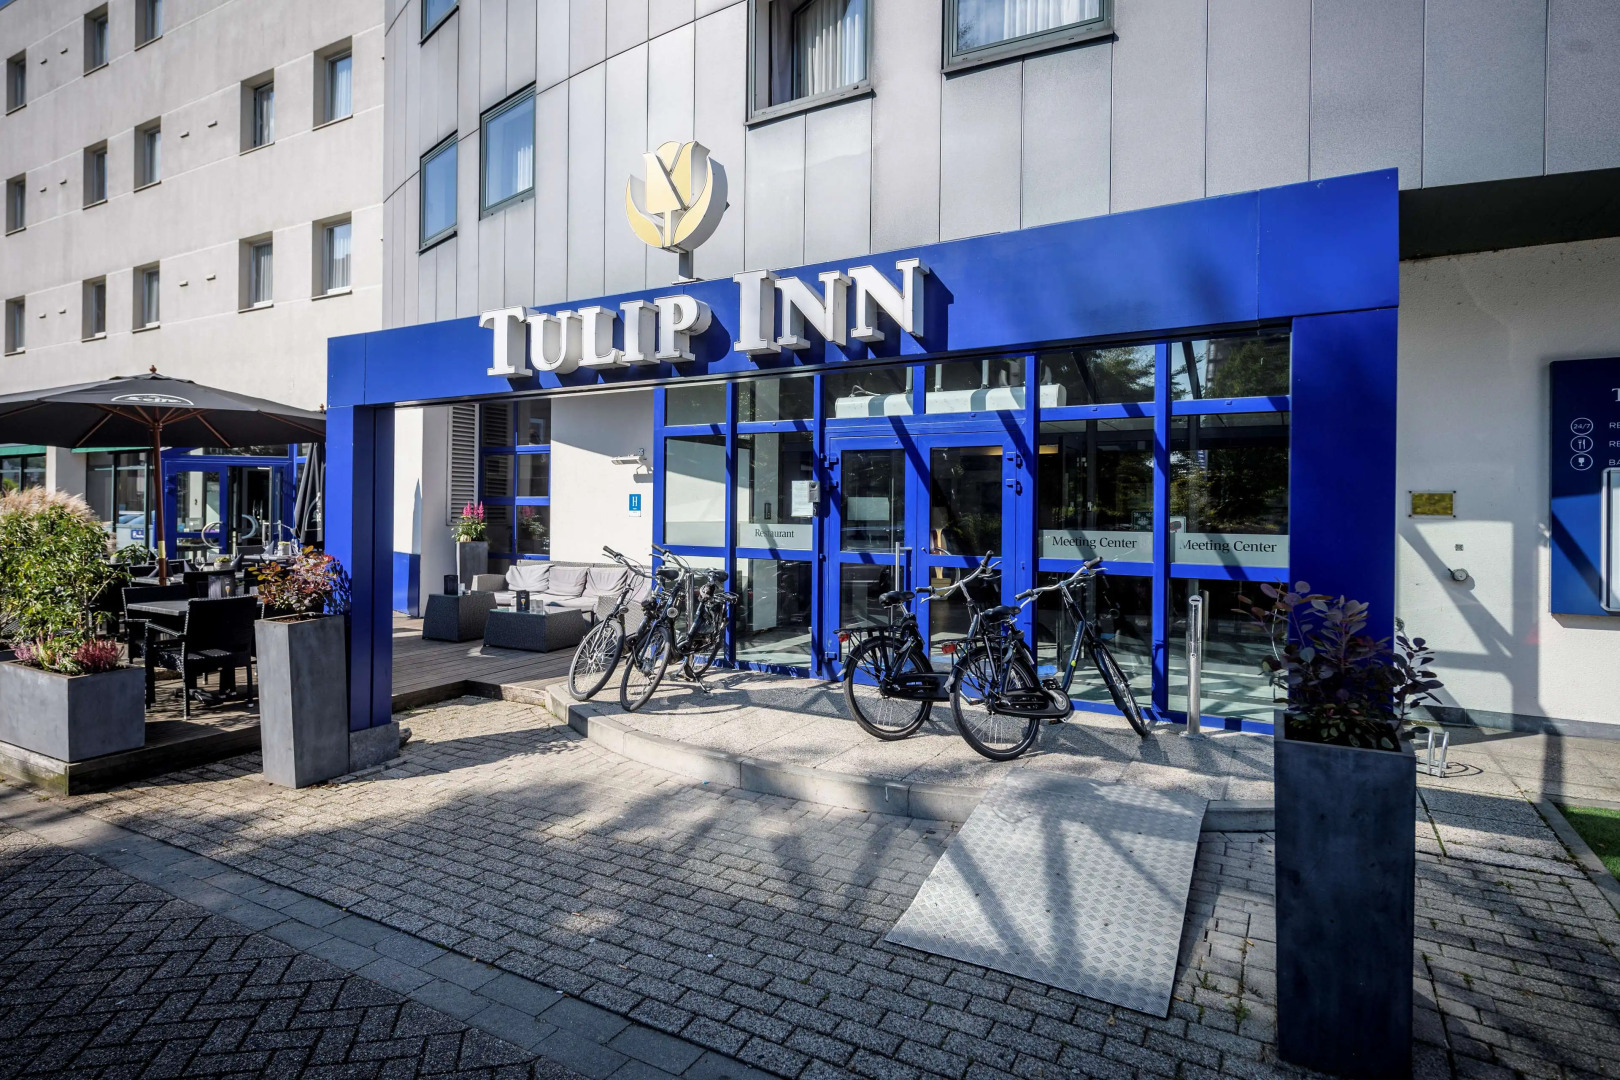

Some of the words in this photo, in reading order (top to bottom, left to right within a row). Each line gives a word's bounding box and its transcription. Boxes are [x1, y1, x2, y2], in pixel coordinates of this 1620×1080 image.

[480, 294, 711, 378] TULIP
[733, 257, 930, 356] INN
[755, 528, 794, 538] Restaurant
[1052, 536, 1097, 550] Meeting
[1099, 537, 1138, 549] Center
[1180, 539, 1230, 554] Meeting
[1233, 540, 1278, 553] Center
